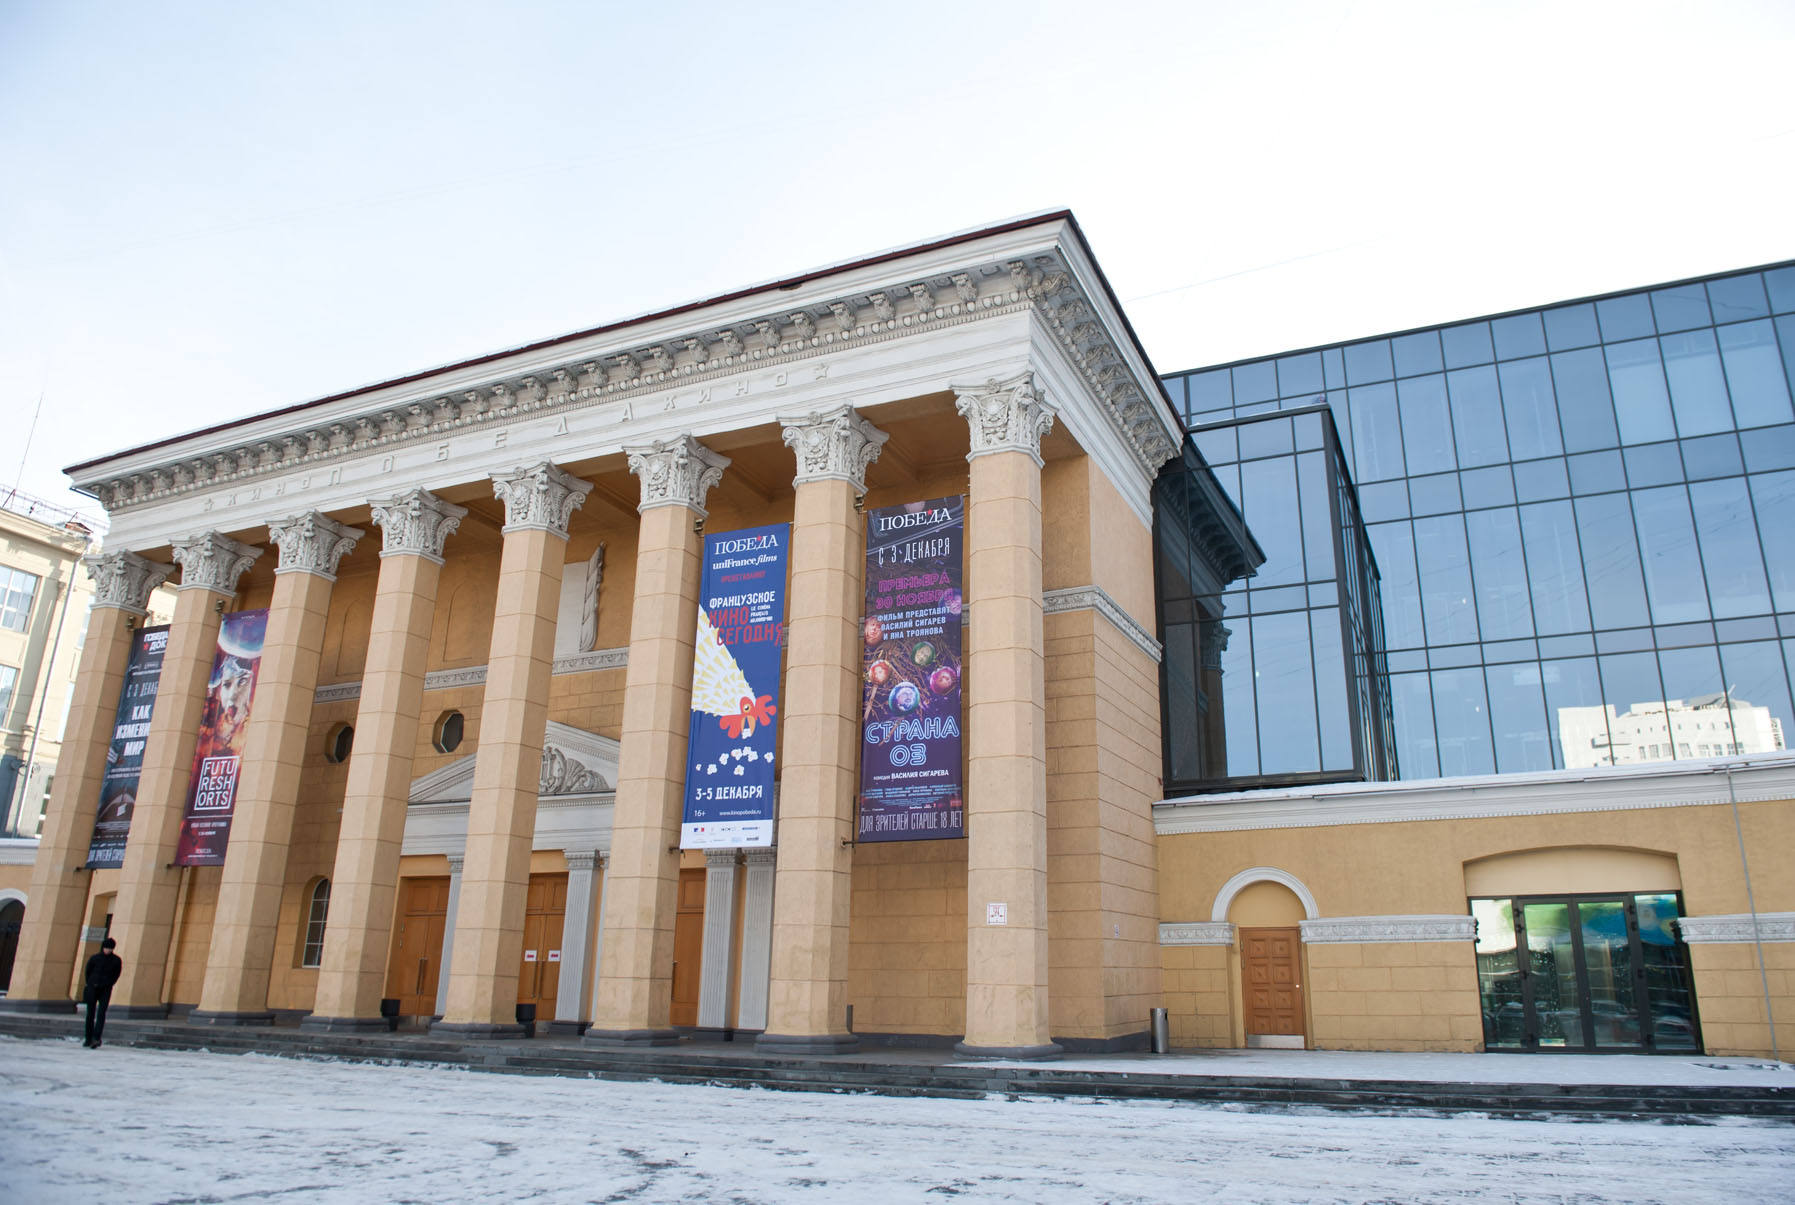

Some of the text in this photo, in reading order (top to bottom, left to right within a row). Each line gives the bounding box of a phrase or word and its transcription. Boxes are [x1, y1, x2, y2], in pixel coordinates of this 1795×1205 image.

[328, 401, 634, 488] ПОБЕДА
[663, 370, 789, 411] КИНО
[880, 508, 952, 532] ПОБЕДА
[714, 534, 779, 555] ПОБЕДА
[878, 538, 950, 565] С 3 ДЕКАБРЯ
[878, 571, 950, 592] ПРЕМЬЕРА
[709, 591, 776, 609] ФРАНЦУЗСКОЕ
[876, 588, 953, 609] 30 НОЯБРЯ
[709, 606, 749, 628] КИНО
[877, 606, 950, 622] ФИЛЬМ ПРЕДСТАВЯТ
[881, 616, 946, 631] ВАСИЛИЙ СИГАРЕВ
[717, 622, 783, 646] СЕГОДНЯ
[890, 630, 904, 639] ЯНА
[906, 627, 943, 638] ТРОЯНОВА
[132, 704, 151, 720] КАК
[116, 722, 151, 739] ИЗМЕНИ
[865, 716, 960, 744] СТРАНА
[124, 741, 145, 756] МИР
[204, 760, 234, 776] FUTU
[892, 772, 918, 780] ВАСИЛИЯ
[919, 770, 949, 778] СИГАРЕВА
[200, 776, 232, 791] RESH
[198, 791, 228, 806] ORTS
[696, 785, 763, 800] 3-5 ДЕКАБРЯ
[860, 810, 963, 834] ДЛЯ ЗРИТЕЛЕЙ СТАРШЕ 18 ЛЕТ
